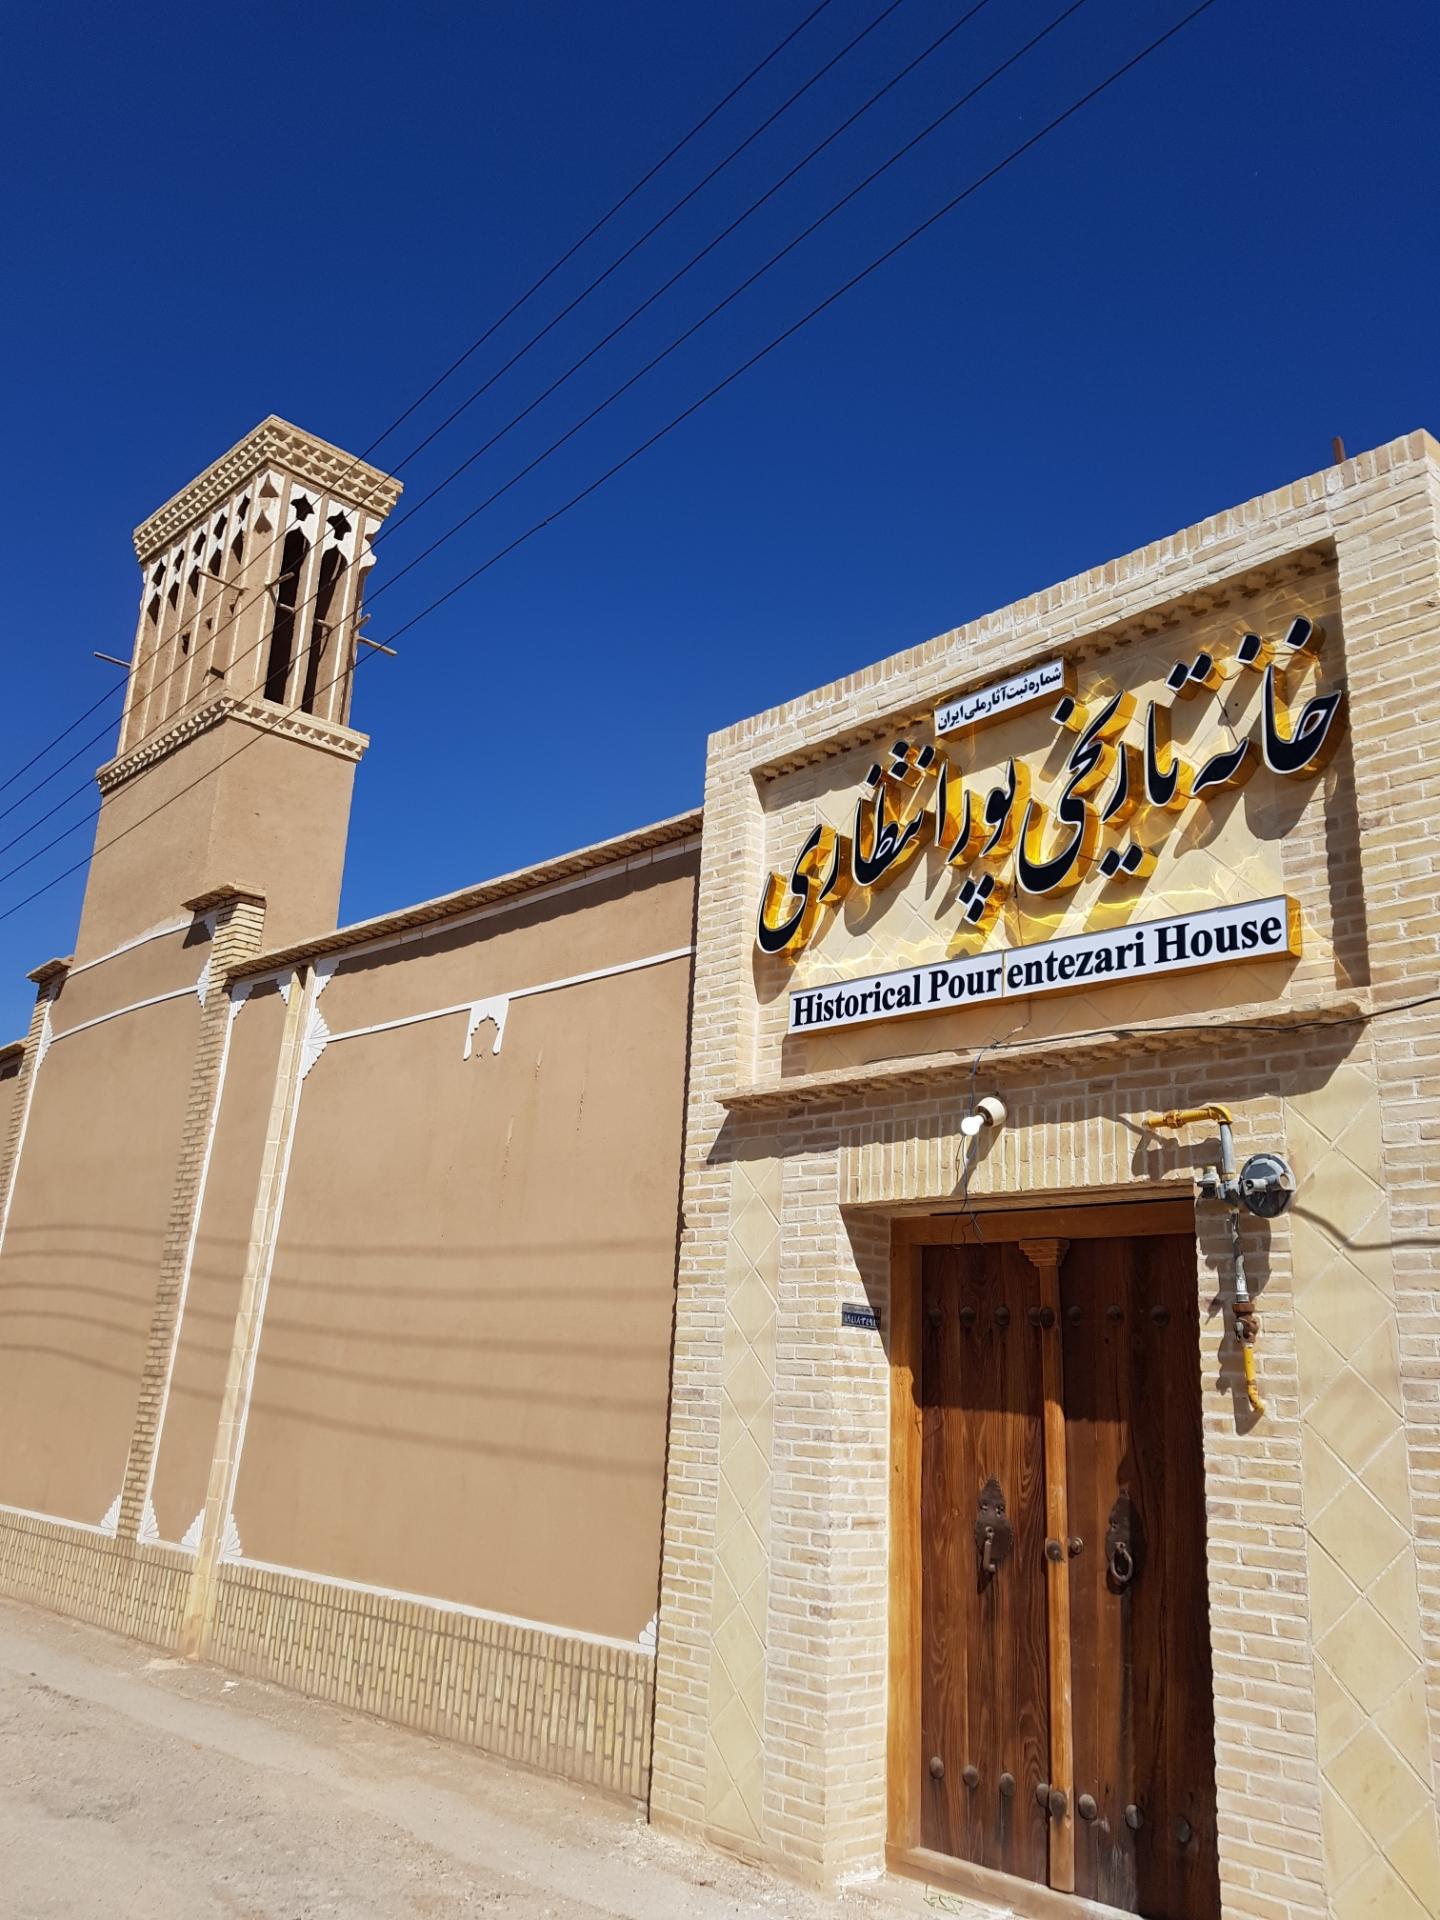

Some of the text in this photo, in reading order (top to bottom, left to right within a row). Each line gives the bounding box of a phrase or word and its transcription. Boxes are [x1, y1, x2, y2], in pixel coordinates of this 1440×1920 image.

[937, 667, 1062, 730] شماره ثبت آثار ملی ایران
[1190, 615, 1342, 795] خانه
[792, 916, 1283, 1028] Historical Pour entezari House
